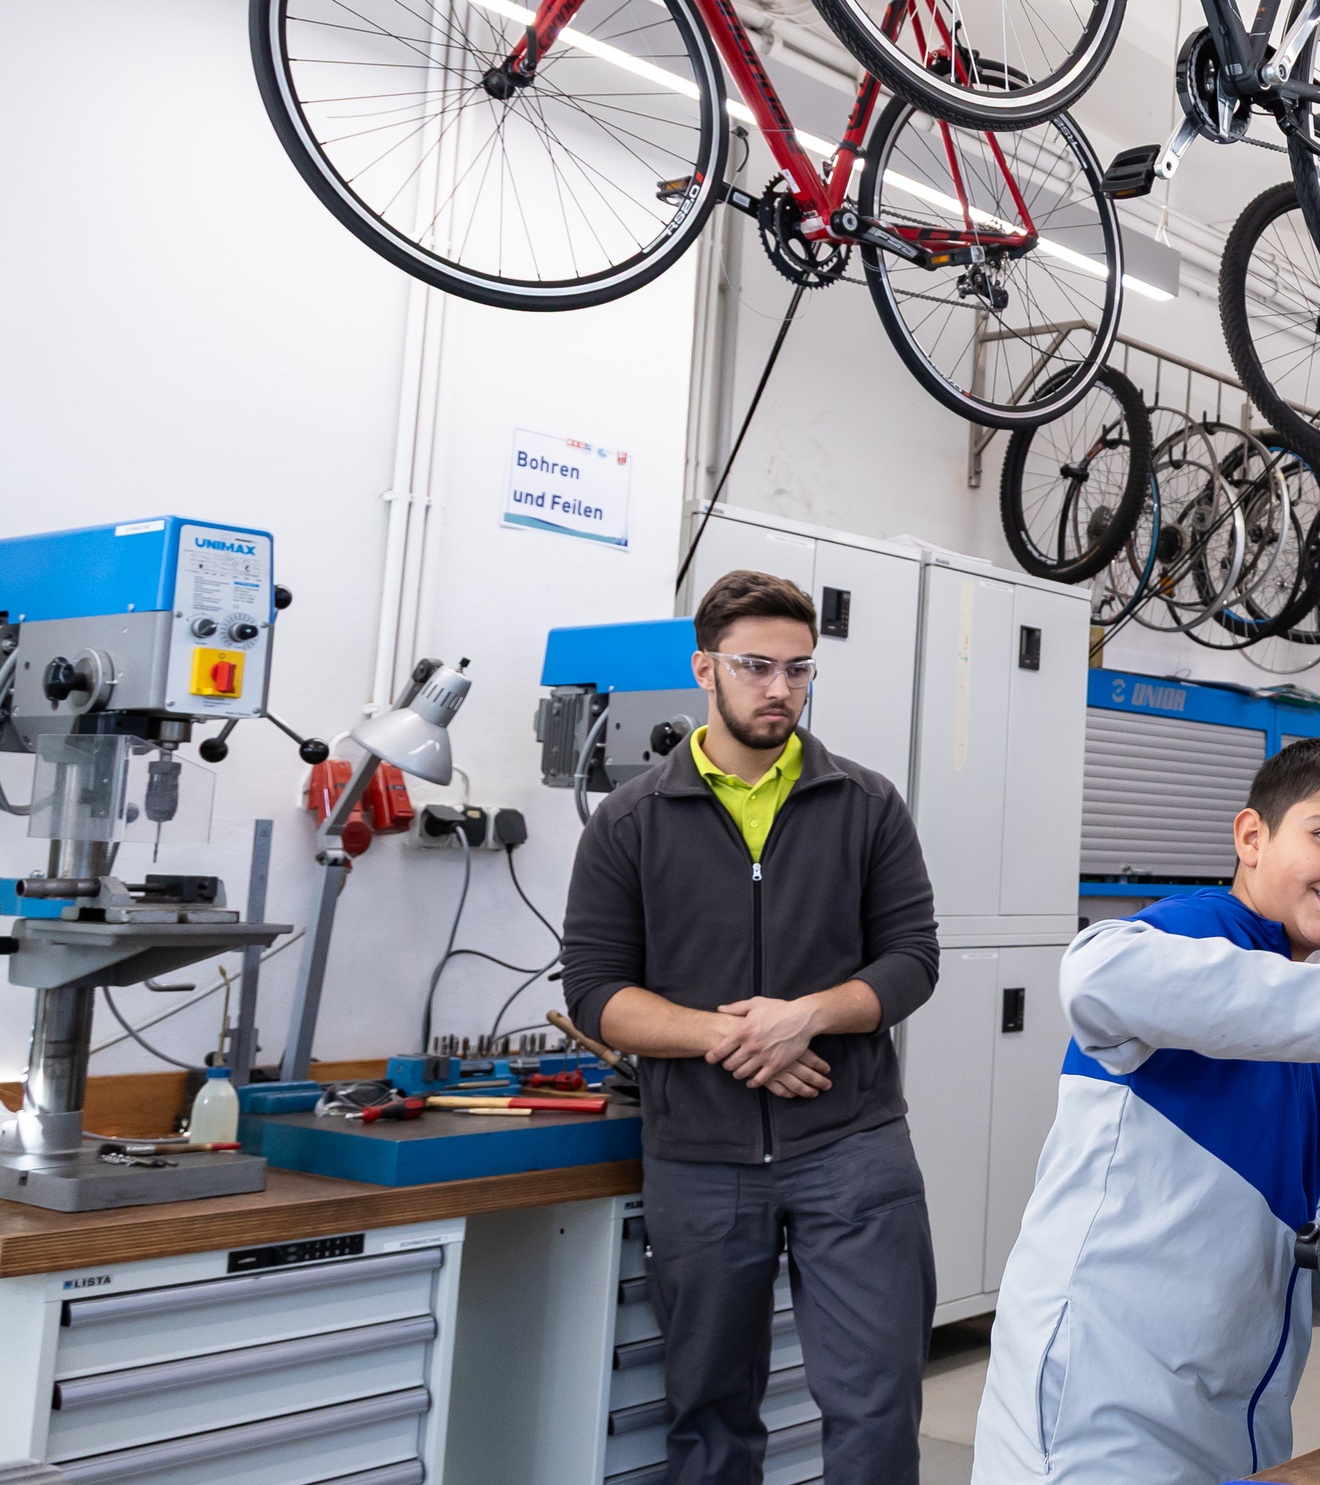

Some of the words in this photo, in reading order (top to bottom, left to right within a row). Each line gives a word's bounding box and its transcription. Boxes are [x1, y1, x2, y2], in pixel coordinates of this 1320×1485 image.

[667, 184, 701, 236] RS2.0
[517, 450, 580, 480] Bohren
[513, 489, 545, 508] und
[550, 494, 603, 520] Feilen
[195, 537, 256, 556] UNIMAX
[74, 1275, 112, 1288] LISTA
